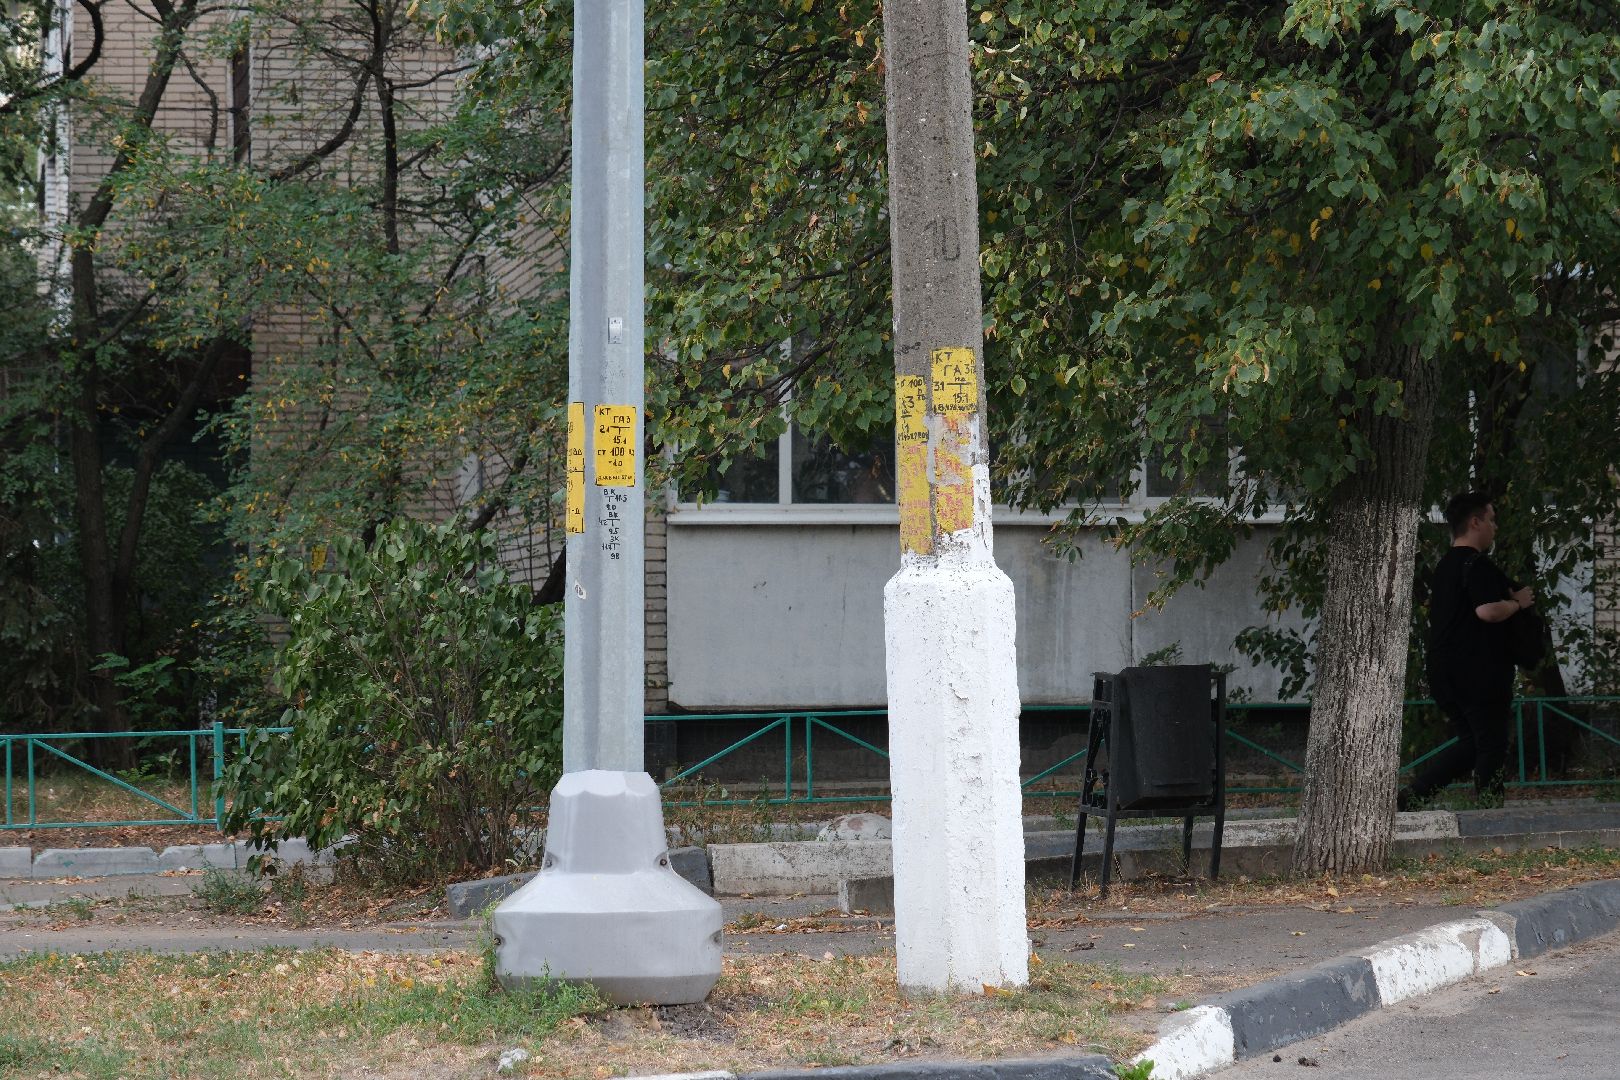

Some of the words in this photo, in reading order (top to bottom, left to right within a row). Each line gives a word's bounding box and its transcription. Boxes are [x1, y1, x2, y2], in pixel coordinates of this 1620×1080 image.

[943, 363, 970, 377] ГАЗ
[599, 407, 611, 416] КТ
[613, 415, 631, 424] ГАЗ
[609, 447, 625, 457] 100
